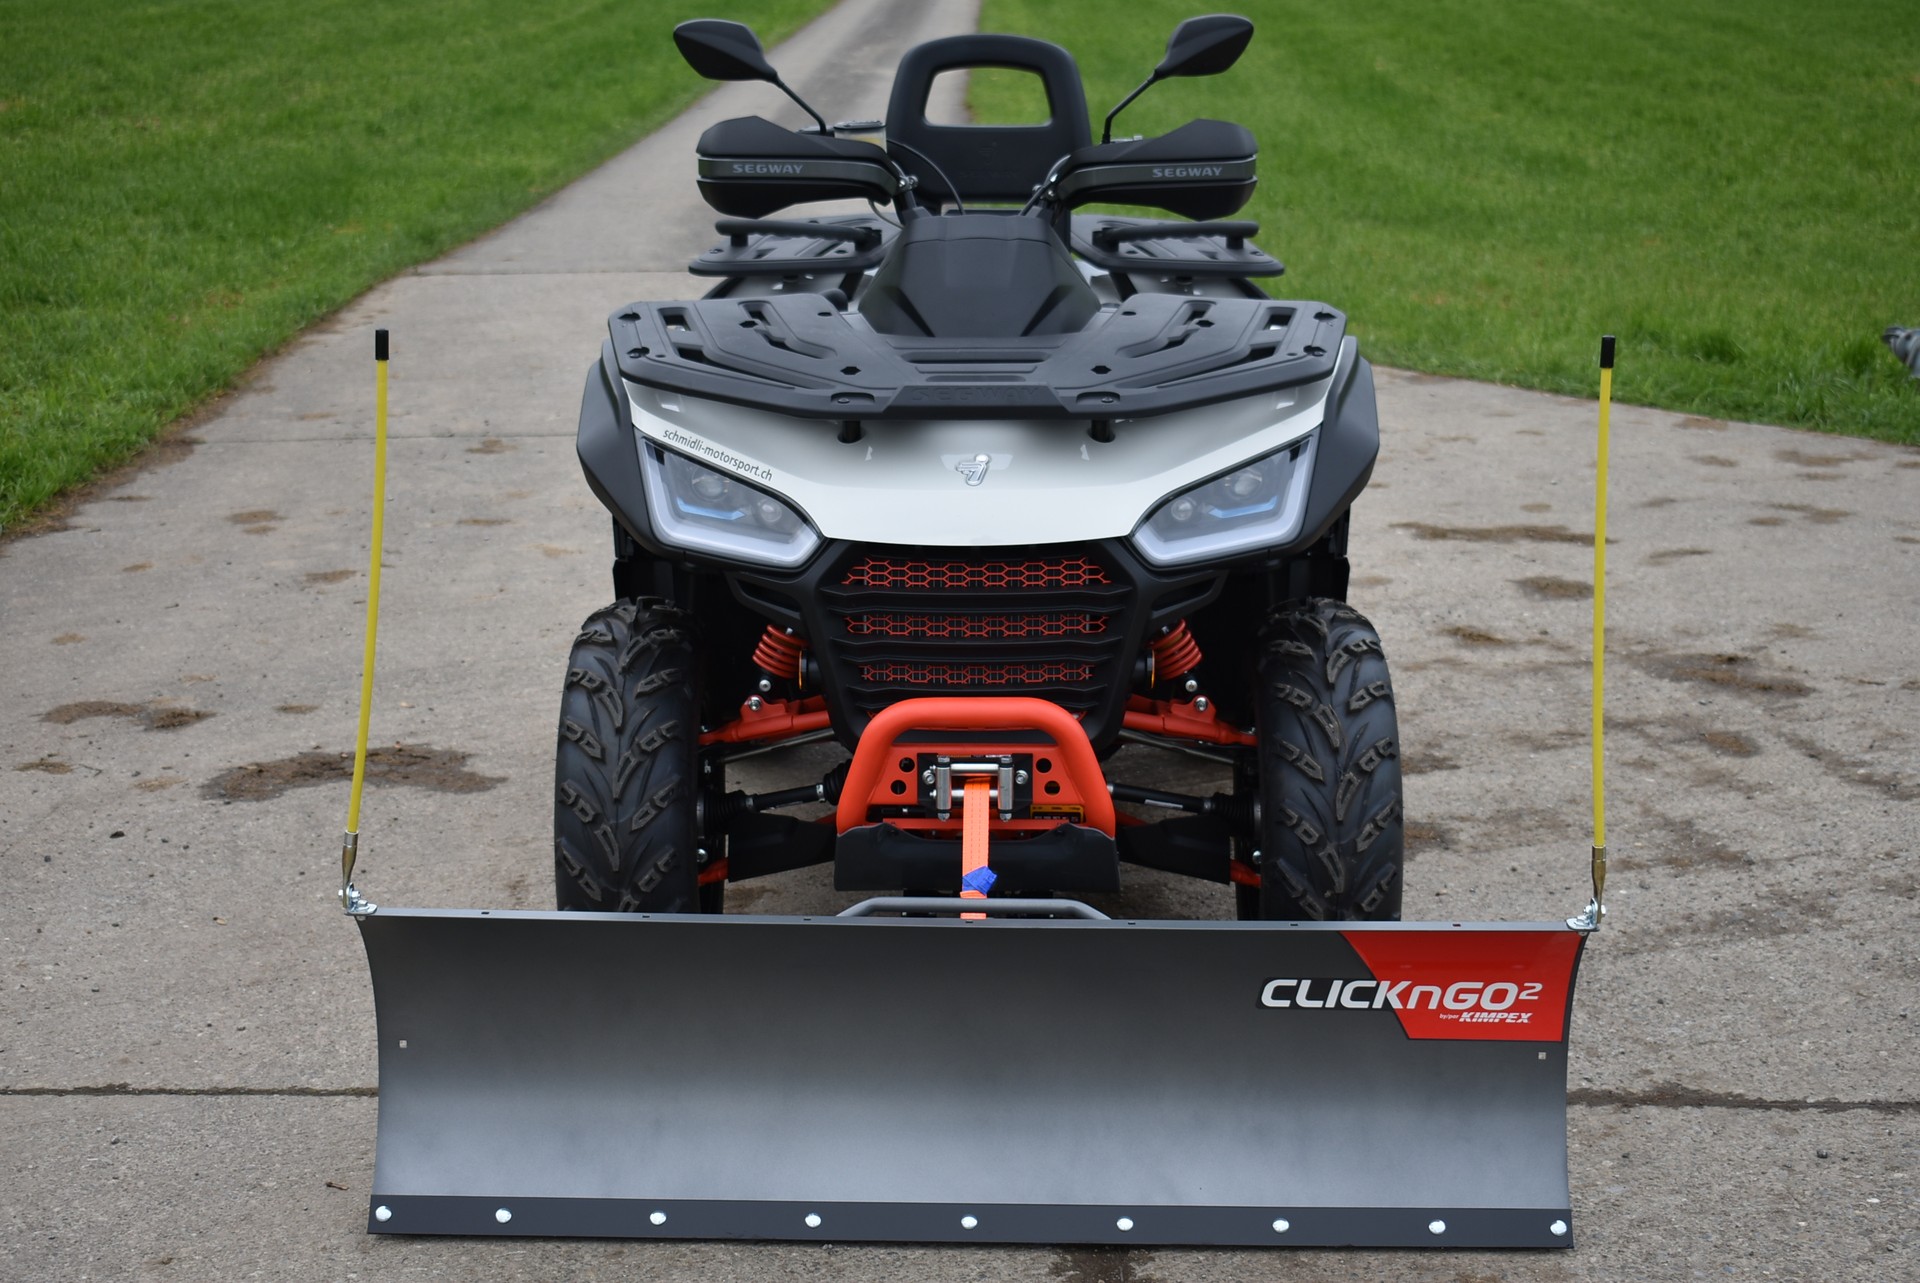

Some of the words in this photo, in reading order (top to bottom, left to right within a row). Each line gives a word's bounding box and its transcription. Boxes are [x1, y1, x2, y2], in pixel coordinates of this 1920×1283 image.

[733, 163, 804, 174] SEGWAY
[1152, 167, 1223, 178] SEGWAY
[663, 429, 773, 482] schmidli-motorsport.ch
[1459, 1012, 1533, 1023] KIMPEX
